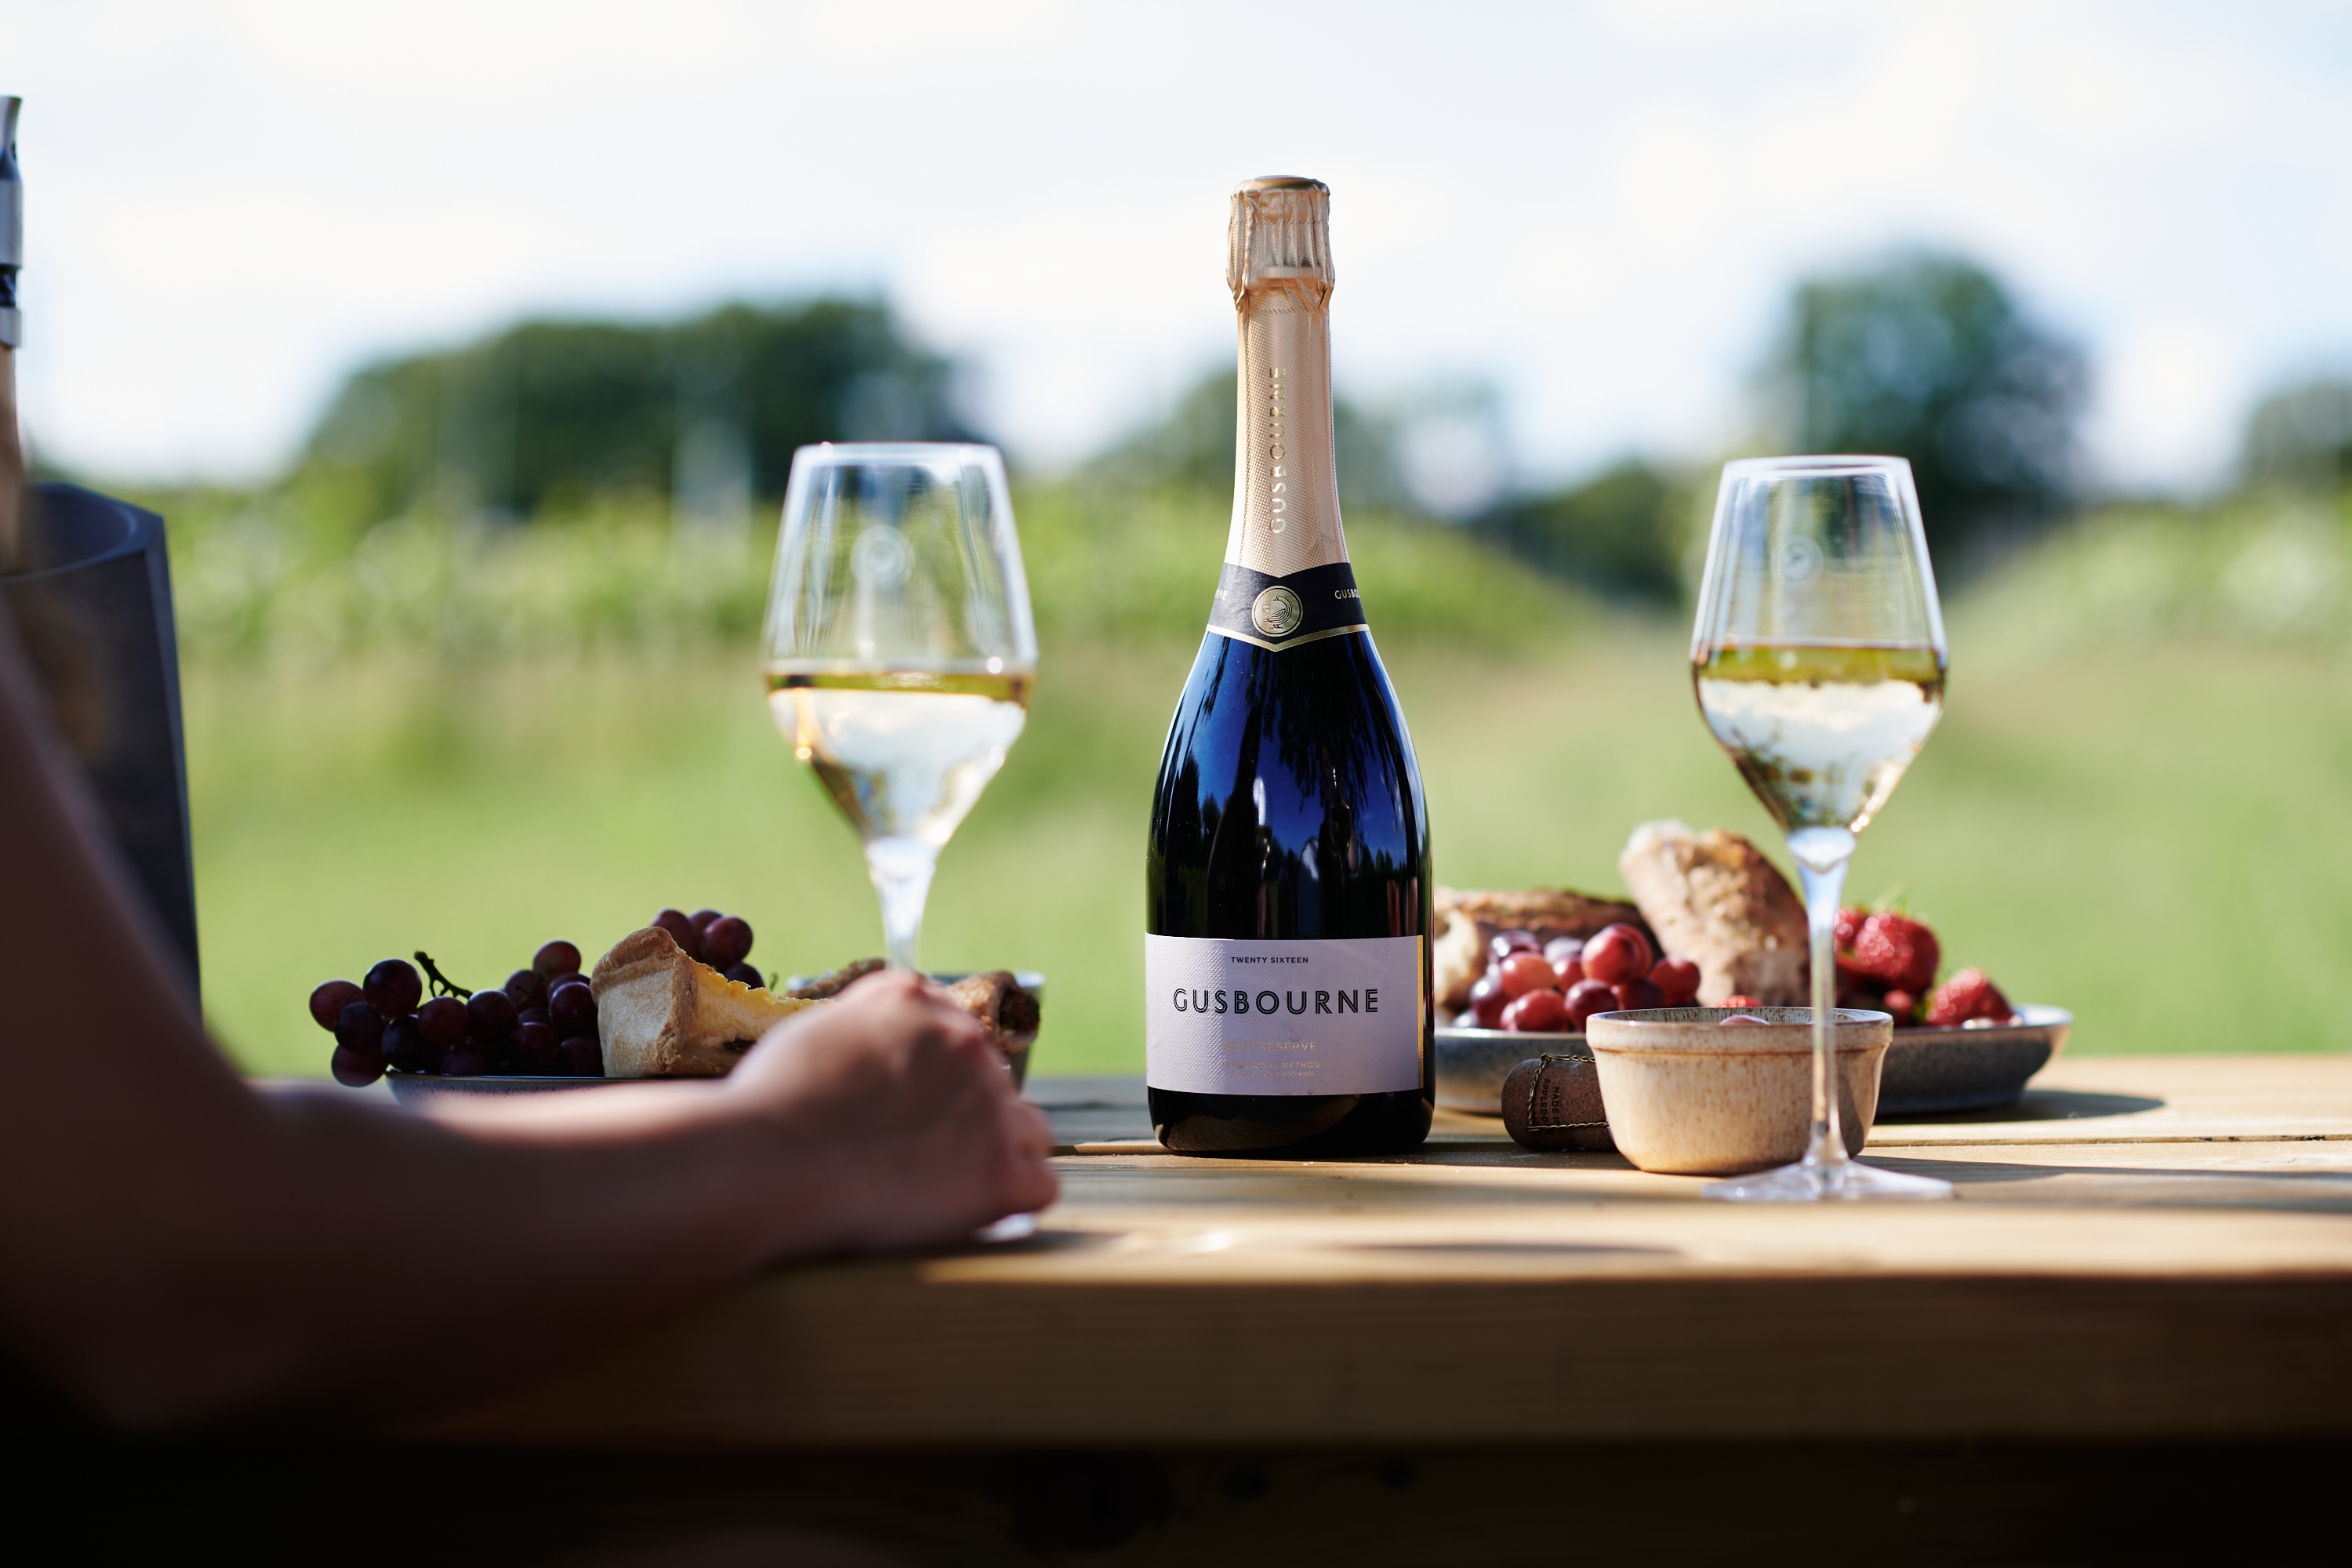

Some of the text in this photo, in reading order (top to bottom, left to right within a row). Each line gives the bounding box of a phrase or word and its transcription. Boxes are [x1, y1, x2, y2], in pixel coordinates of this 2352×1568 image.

[1269, 367, 1287, 534] GUSBOURNE
[1334, 589, 1360, 600] GUSBO
[1173, 988, 1378, 1014] GUSBOURNE
[1223, 1041, 1316, 1051] BRUT RESERVE
[1540, 1078, 1553, 1134] APPLEDOE
[1551, 1087, 1561, 1126] MADE IN
